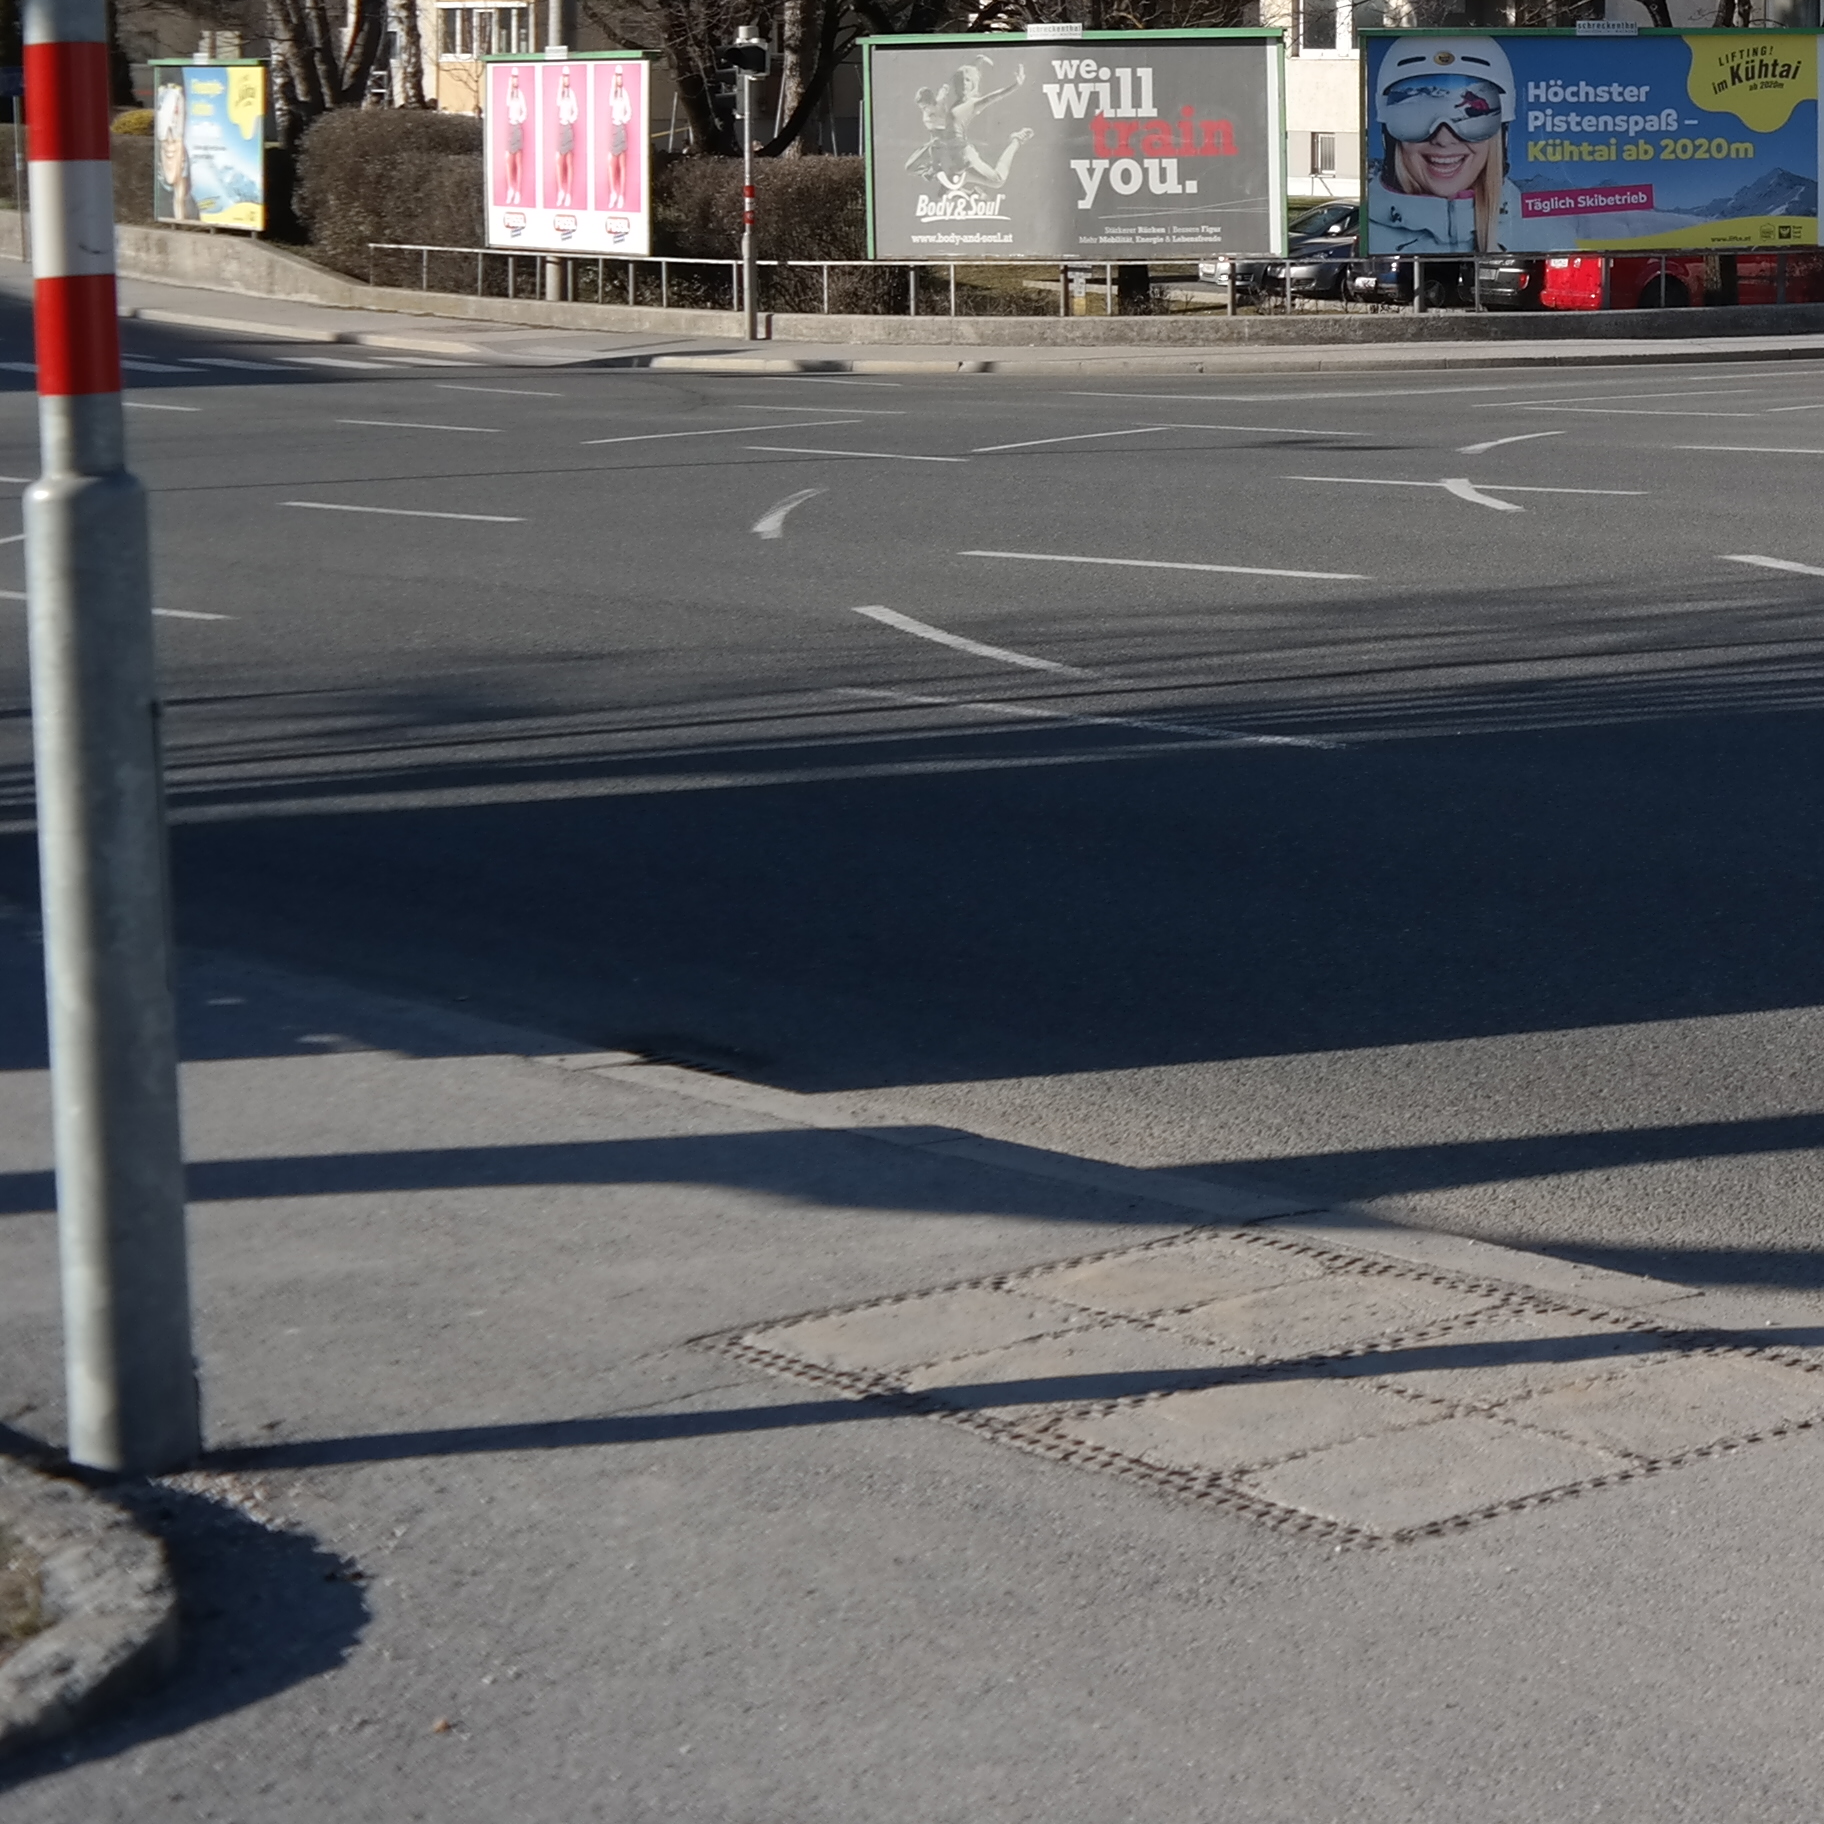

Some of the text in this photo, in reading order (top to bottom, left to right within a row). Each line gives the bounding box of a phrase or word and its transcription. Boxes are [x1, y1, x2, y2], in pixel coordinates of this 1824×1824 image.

[1718, 46, 1774, 66] LIFTING!
[1052, 59, 1098, 80] we
[1711, 59, 1802, 95] im Kühtai
[1043, 67, 1158, 119] will
[1528, 80, 1650, 103] Höchster
[1090, 105, 1239, 159] train
[1528, 108, 1678, 136] Pistenspaß
[1527, 137, 1754, 162] Kühtai ab 2020m
[1070, 158, 1198, 209] you.
[1526, 192, 1647, 212] Täglich Skibetrieb
[911, 233, 1013, 246] www.body-and-soul.at
